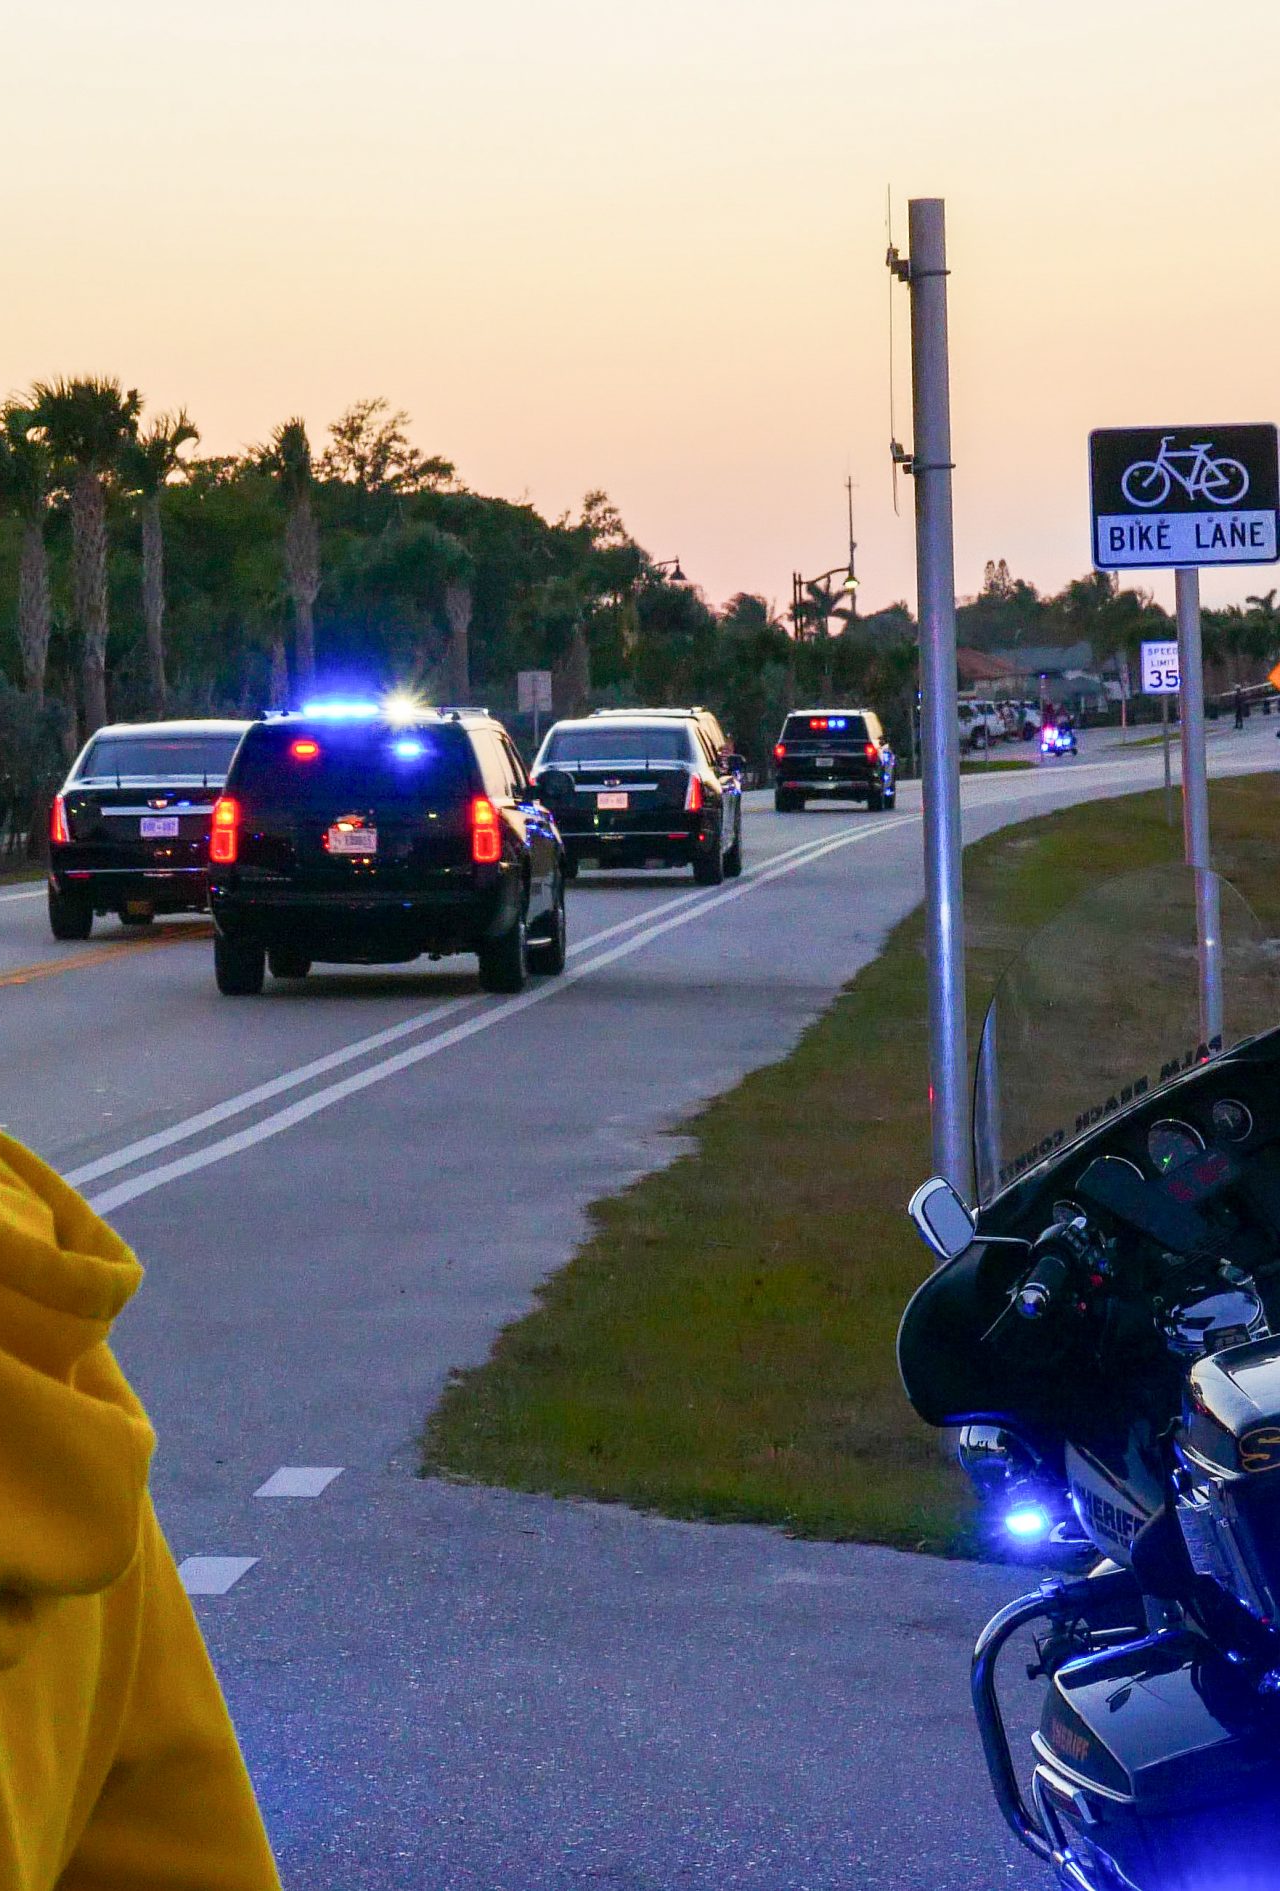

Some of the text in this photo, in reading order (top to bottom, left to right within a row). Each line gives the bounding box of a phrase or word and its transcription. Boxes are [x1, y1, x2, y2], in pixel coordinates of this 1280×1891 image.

[1109, 521, 1265, 551] BIKE LANE
[1147, 647, 1178, 656] SPEED
[1151, 659, 1175, 667] LIMIT
[1149, 669, 1179, 688] 35
